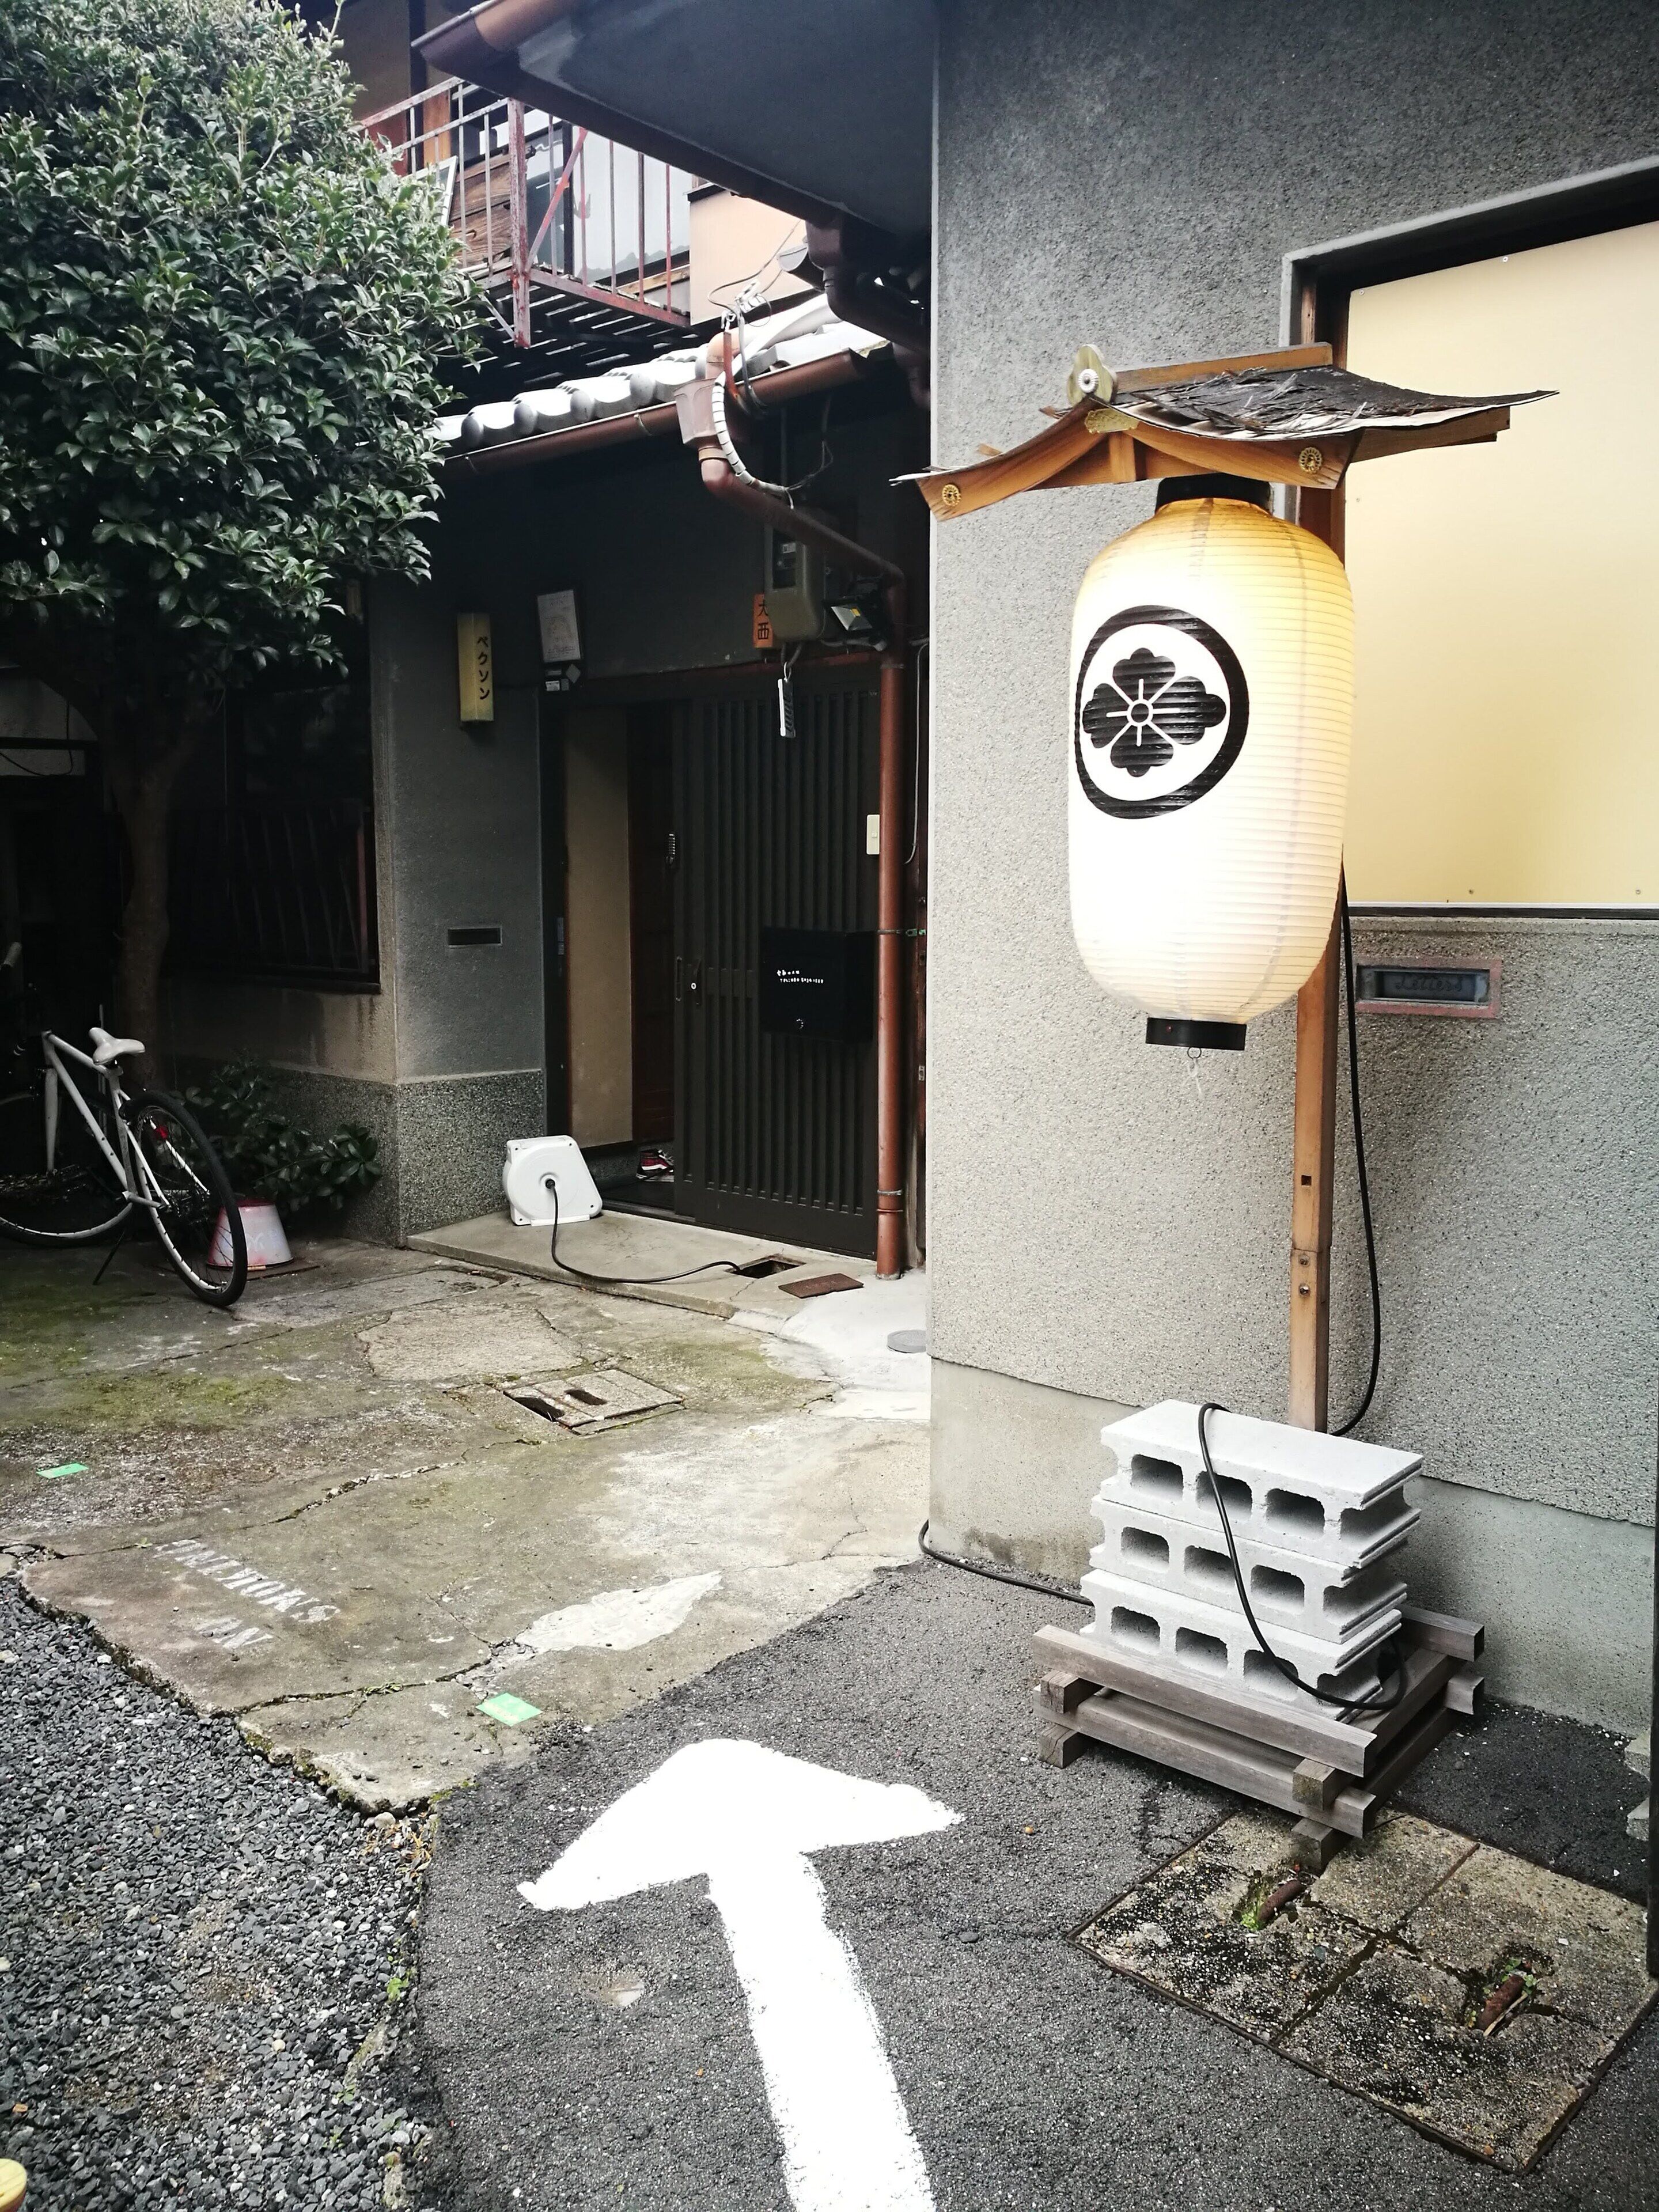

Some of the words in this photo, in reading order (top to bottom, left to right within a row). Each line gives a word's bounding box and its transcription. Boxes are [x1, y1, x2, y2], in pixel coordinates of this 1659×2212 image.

[757, 600, 769, 639] 大西
[1395, 974, 1463, 991] Letters
[153, 1539, 340, 1623] SMOKING
[195, 1617, 274, 1649] NO
